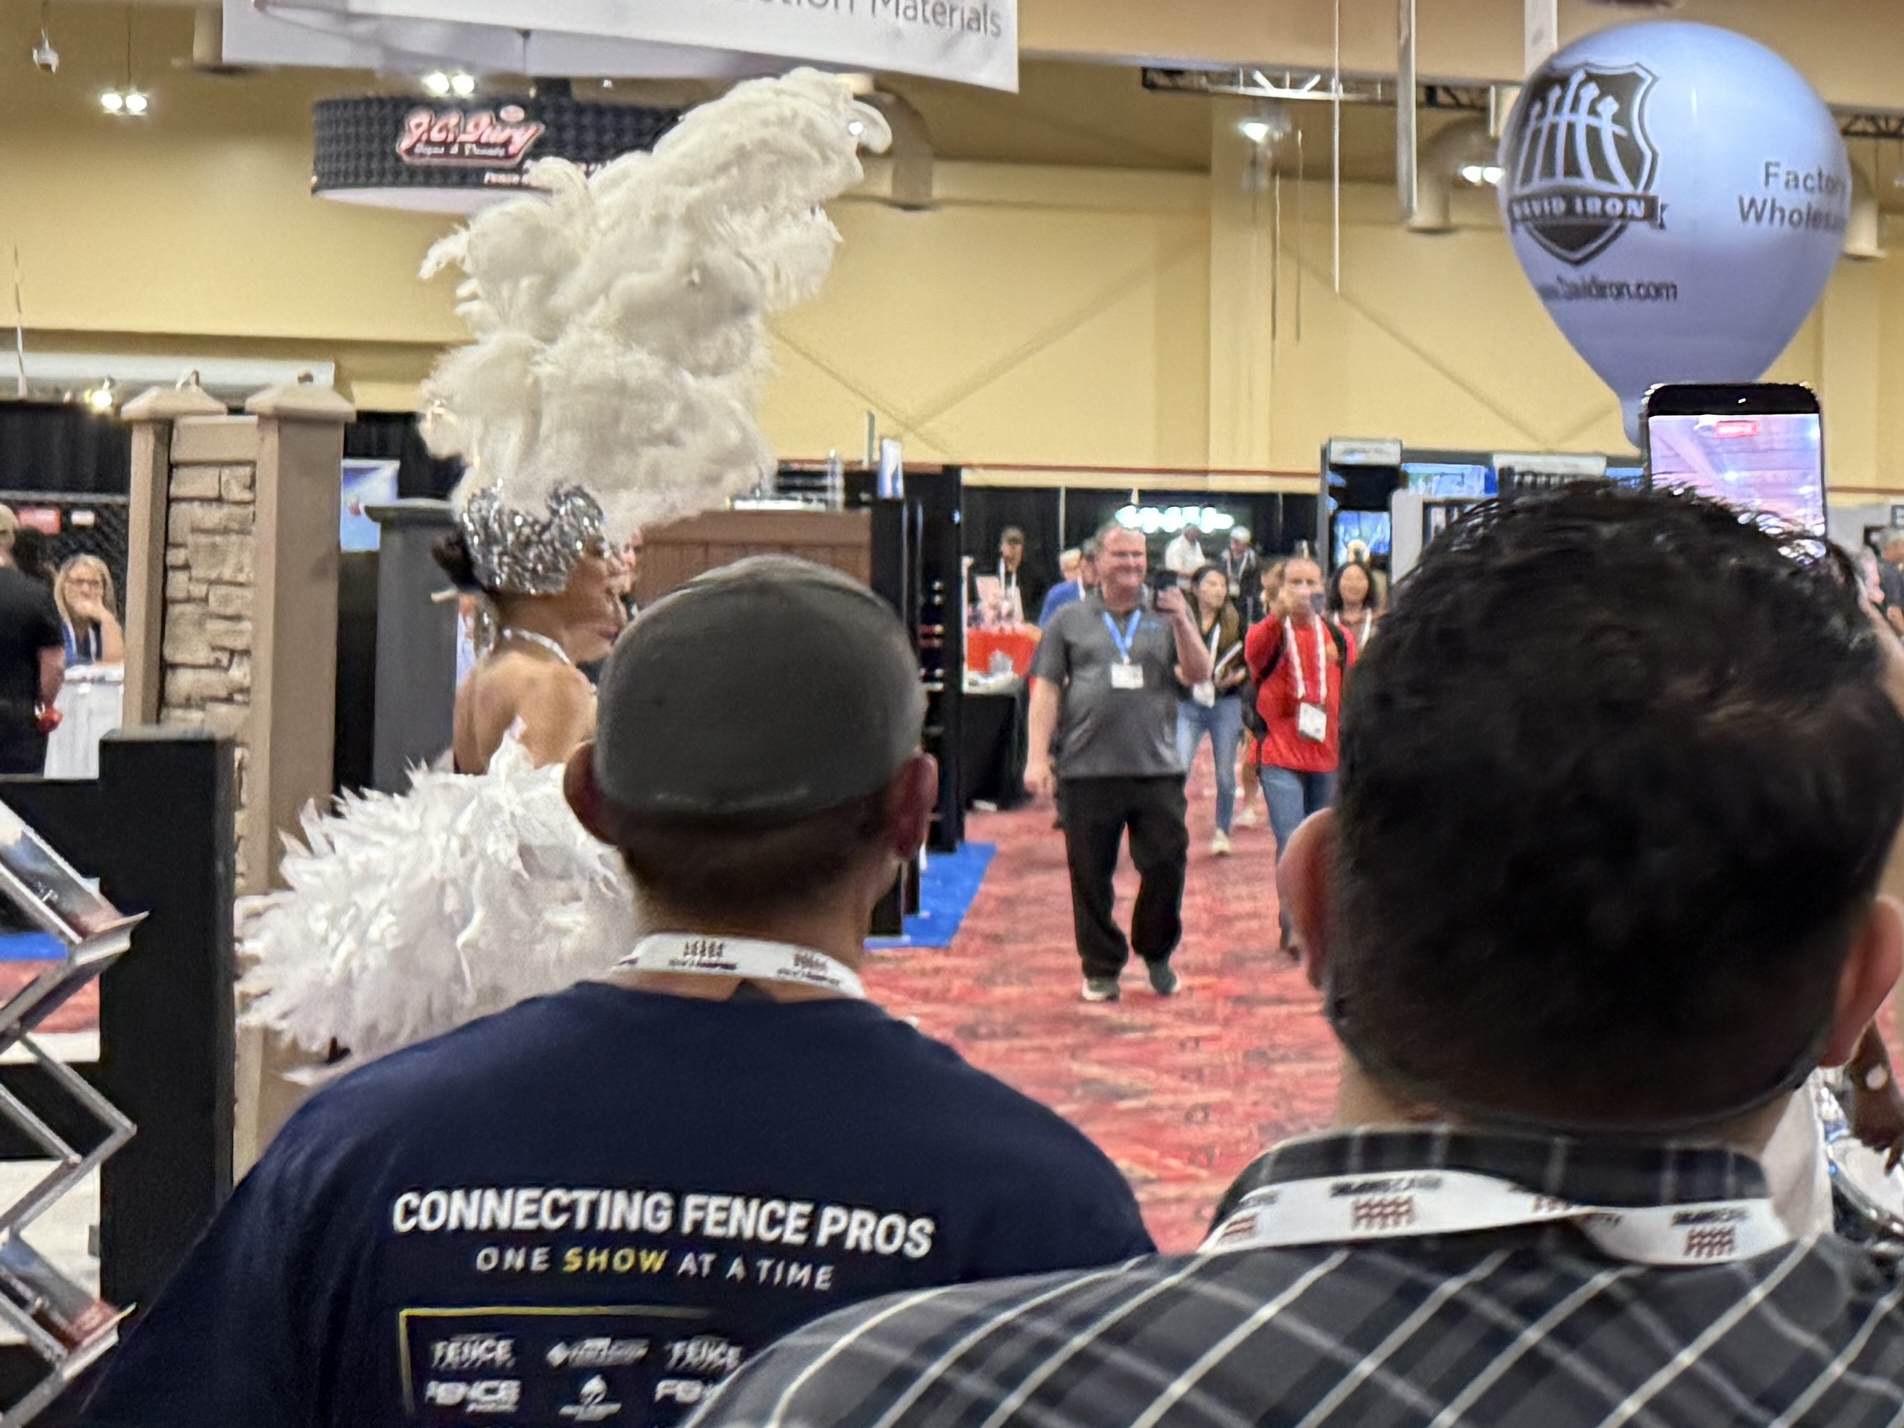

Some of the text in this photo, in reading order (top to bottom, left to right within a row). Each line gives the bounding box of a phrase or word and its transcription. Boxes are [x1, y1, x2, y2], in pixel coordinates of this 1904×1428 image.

[1574, 198, 1645, 220] IRON
[392, 1188, 936, 1259] CONNECTING FENCE PROS
[476, 1246, 836, 1291] ONE SHOW AT A TIME
